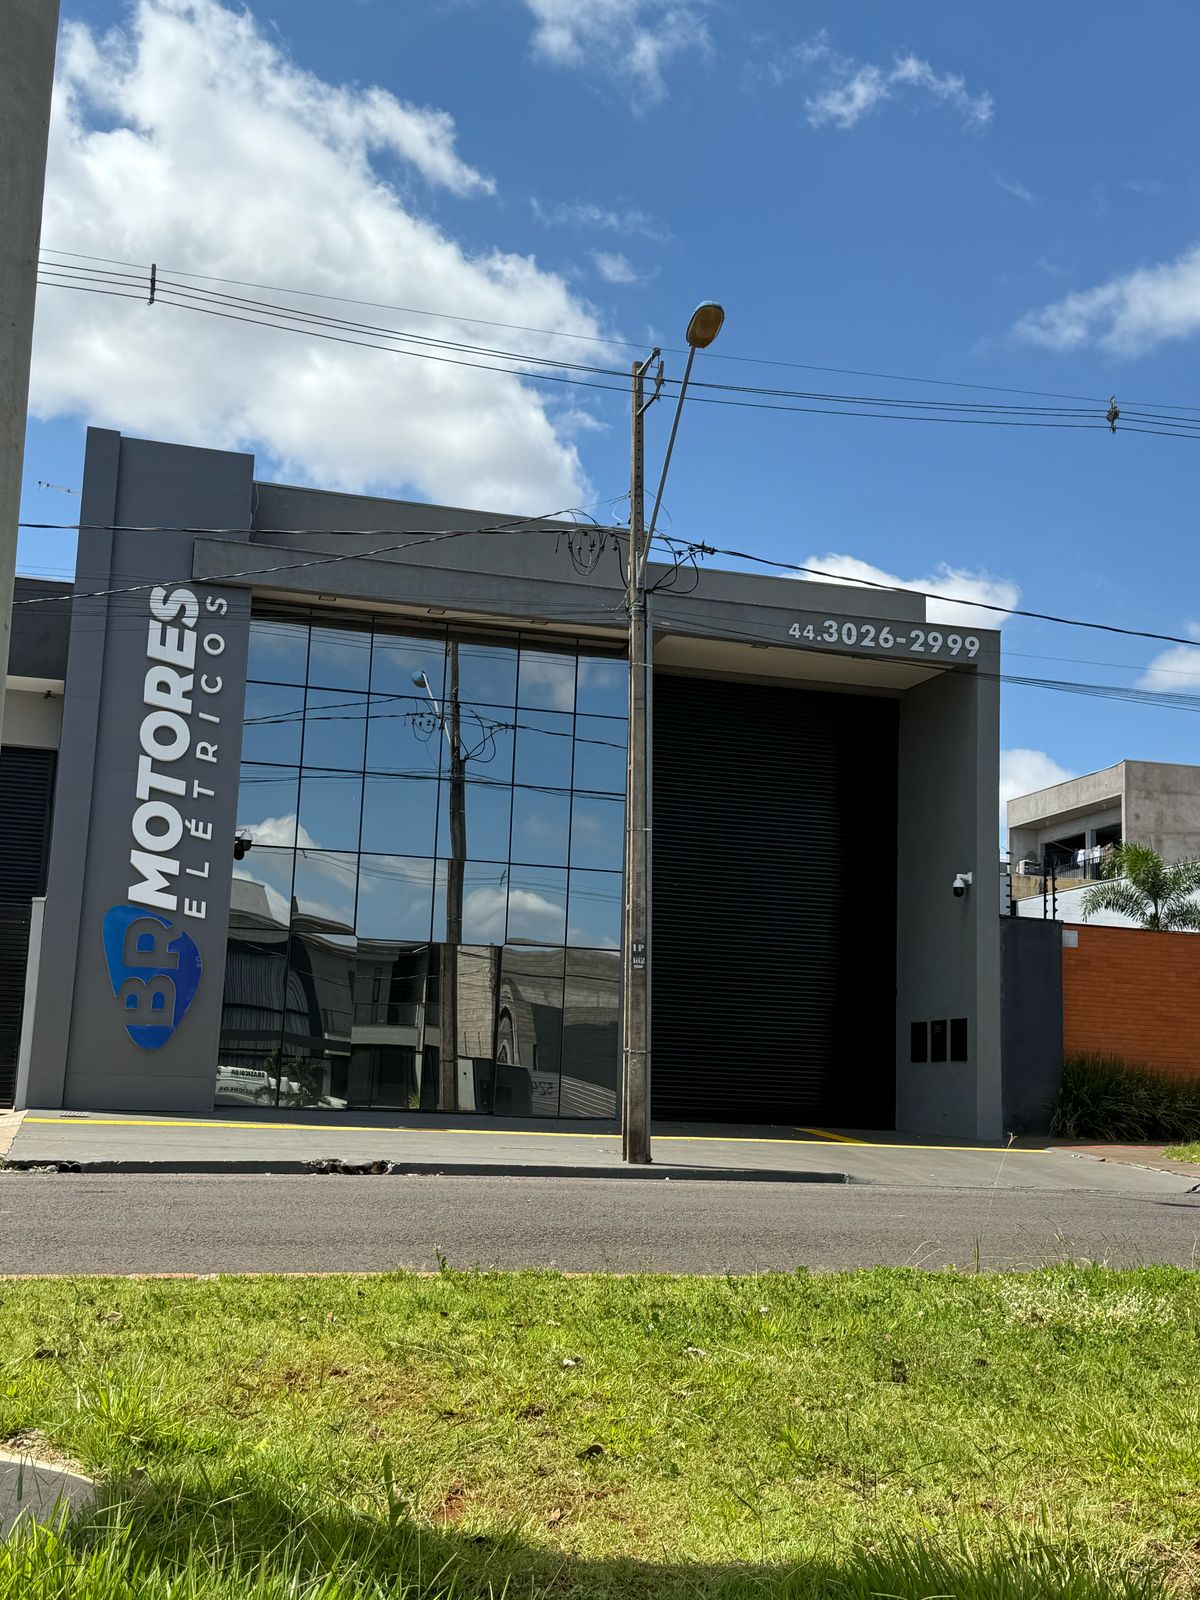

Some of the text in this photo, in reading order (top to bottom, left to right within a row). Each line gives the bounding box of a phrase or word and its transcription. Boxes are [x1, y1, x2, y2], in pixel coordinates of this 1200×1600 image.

[789, 620, 980, 657] 44.3026-2999
[128, 586, 199, 911] MOTORES
[184, 595, 228, 919] ELÉTRICOS
[120, 916, 180, 1027] BR
